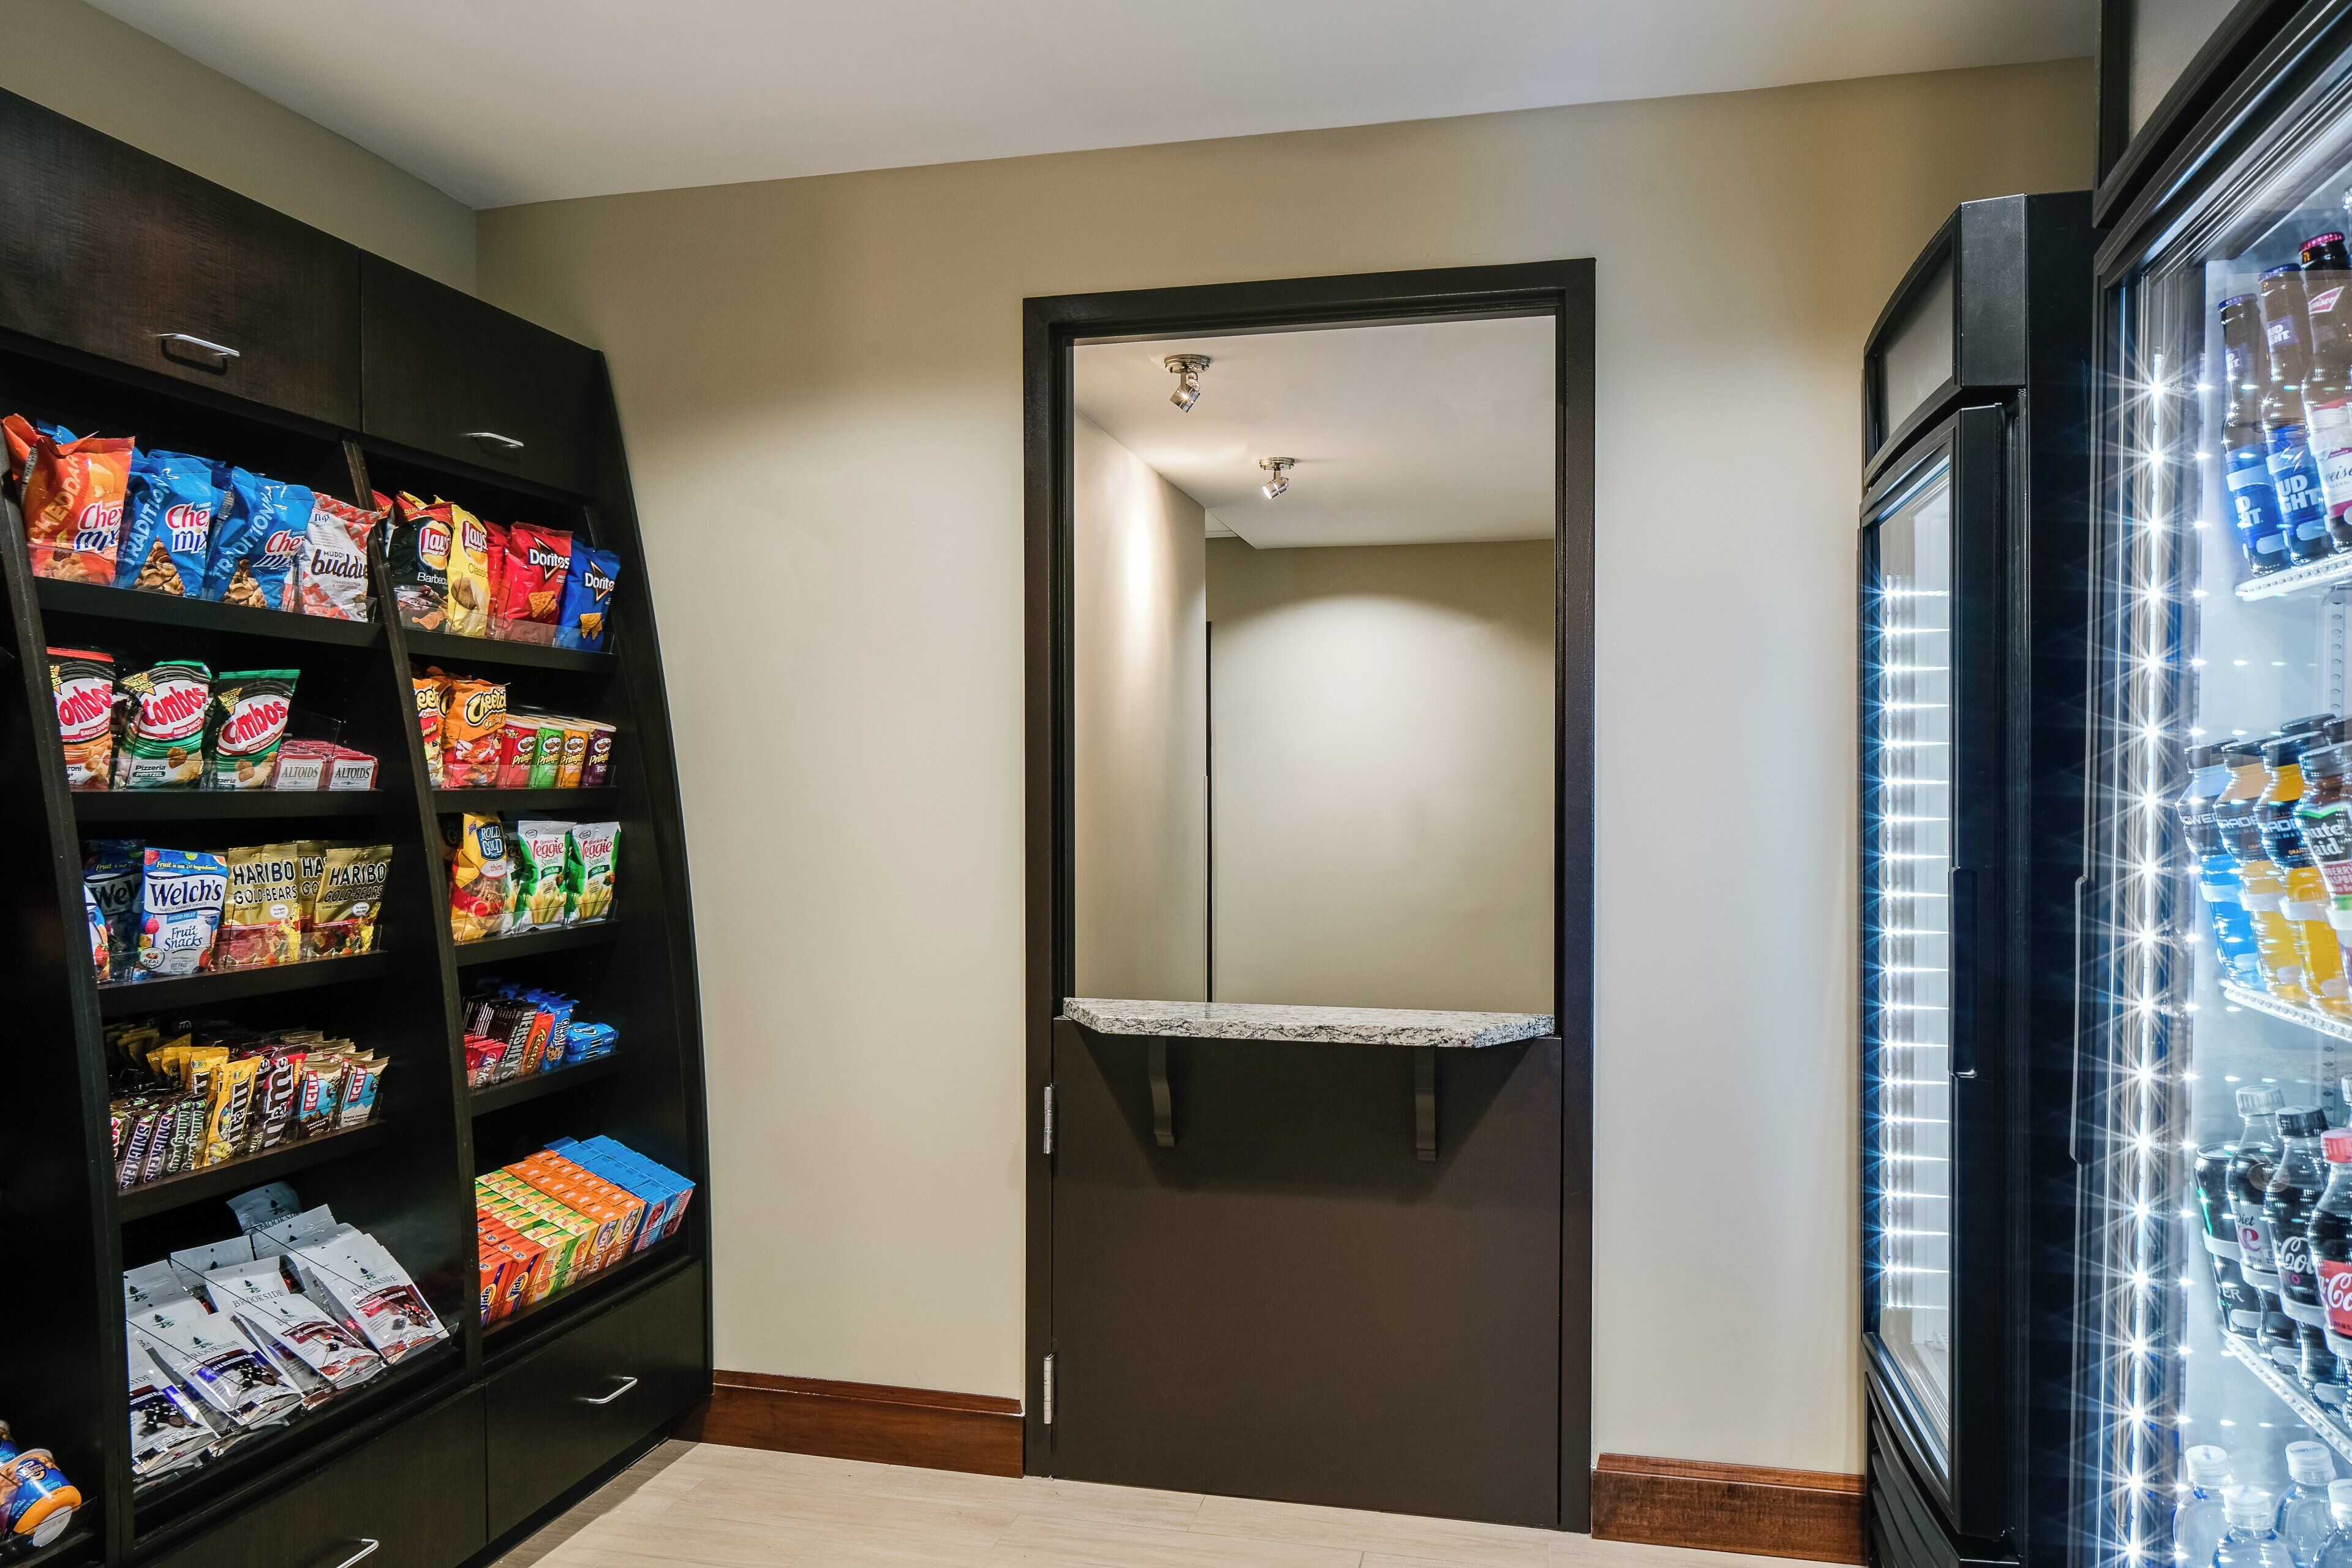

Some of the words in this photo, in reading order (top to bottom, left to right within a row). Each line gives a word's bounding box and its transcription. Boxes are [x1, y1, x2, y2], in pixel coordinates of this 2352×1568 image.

[28, 454, 81, 544] CHEDDAR
[266, 530, 303, 553] Che
[529, 548, 570, 570] Doritos
[130, 678, 149, 687] REAL
[134, 680, 156, 693] CHEESE
[59, 683, 113, 727] ombos
[141, 685, 207, 727] Combos
[221, 692, 238, 702] REAL
[80, 728, 97, 737] BAKED
[173, 726, 187, 736] BAKED
[186, 717, 203, 732] SNACKS
[281, 766, 320, 778] ALTOIDS
[335, 766, 371, 779] ALTOIDS
[481, 826, 501, 841] ROLD
[481, 838, 503, 856] GOLD
[526, 840, 565, 861] Veggie
[578, 840, 613, 861] Veggie
[96, 862, 113, 871] Fruit
[156, 861, 172, 869] Fruit
[232, 860, 296, 886] HARIBO
[301, 856, 328, 878] HA
[328, 862, 387, 887] HARIBO
[149, 879, 222, 907] Welch's
[233, 884, 298, 905] GOLD-BEARS
[323, 885, 384, 903] GOLD-BEARS
[171, 925, 198, 940] Fruit
[164, 935, 203, 952] Snacks
[501, 1010, 538, 1080] HERSHEY'S
[307, 1073, 319, 1102] CLIF
[352, 1067, 367, 1095] CLIF
[307, 1117, 329, 1128] CHOCOLATE
[145, 1117, 173, 1182] SNICKERS
[249, 1133, 260, 1153] MILK
[120, 1123, 151, 1189] SNICKERS
[510, 1275, 524, 1296] Tide
[232, 1289, 284, 1308] BROOKSIDE
[46, 1480, 62, 1490] easy
